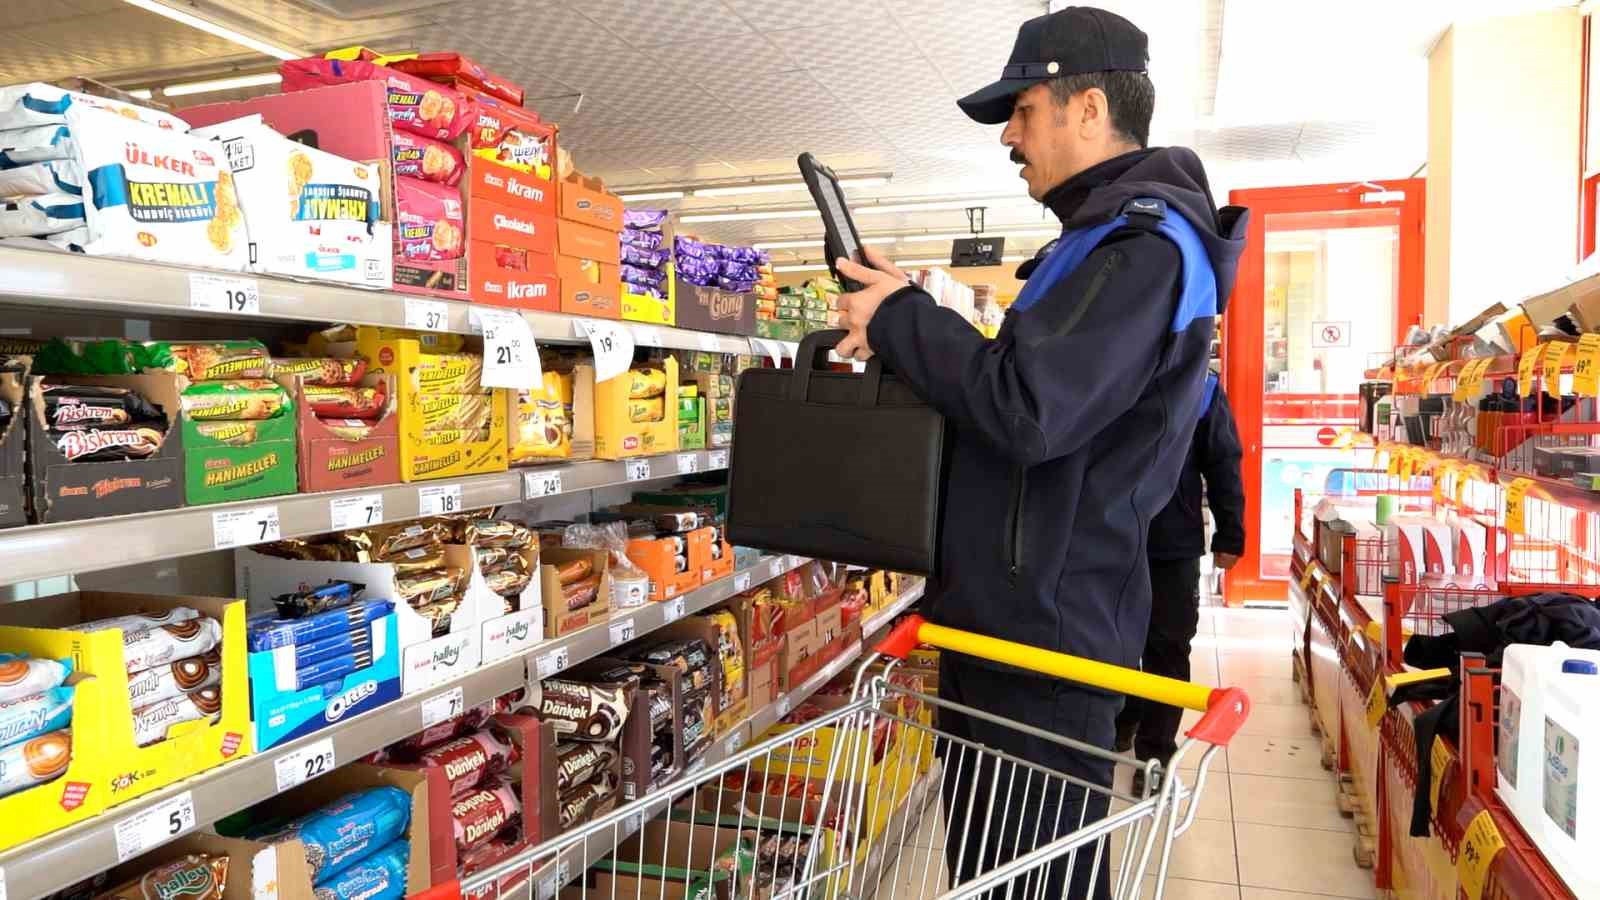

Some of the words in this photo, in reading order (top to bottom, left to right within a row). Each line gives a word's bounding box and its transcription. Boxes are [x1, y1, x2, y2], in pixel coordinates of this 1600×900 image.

[126, 142, 195, 177] ÜLKER
[130, 182, 209, 207] KREMALI
[507, 177, 544, 202] ikram
[226, 290, 247, 311] 19
[507, 281, 547, 299] ikram
[711, 293, 744, 320] Gong
[426, 312, 441, 329] 37
[497, 346, 511, 364] 21
[600, 337, 612, 353] 19
[53, 403, 113, 424] Biskrem
[57, 428, 141, 461] Biskrem
[205, 453, 279, 487] HANIMELLER
[328, 445, 385, 471] HANIMELLER
[414, 449, 461, 475] HANIMELLER
[637, 463, 647, 480] 24
[544, 479, 556, 495] 24
[365, 506, 374, 523] 7
[441, 496, 453, 511] 18
[258, 520, 267, 540] 7
[506, 622, 529, 641] halley
[433, 644, 460, 668] halley
[556, 655, 563, 669] 8
[325, 680, 378, 722] OREO
[449, 699, 456, 715] 7
[543, 700, 588, 719] Dankek
[305, 754, 325, 778] 22
[445, 750, 486, 780] Dankek
[564, 749, 597, 774] Dankek
[169, 810, 182, 834] 5
[466, 809, 504, 843] Dankek
[154, 863, 211, 899] halley
